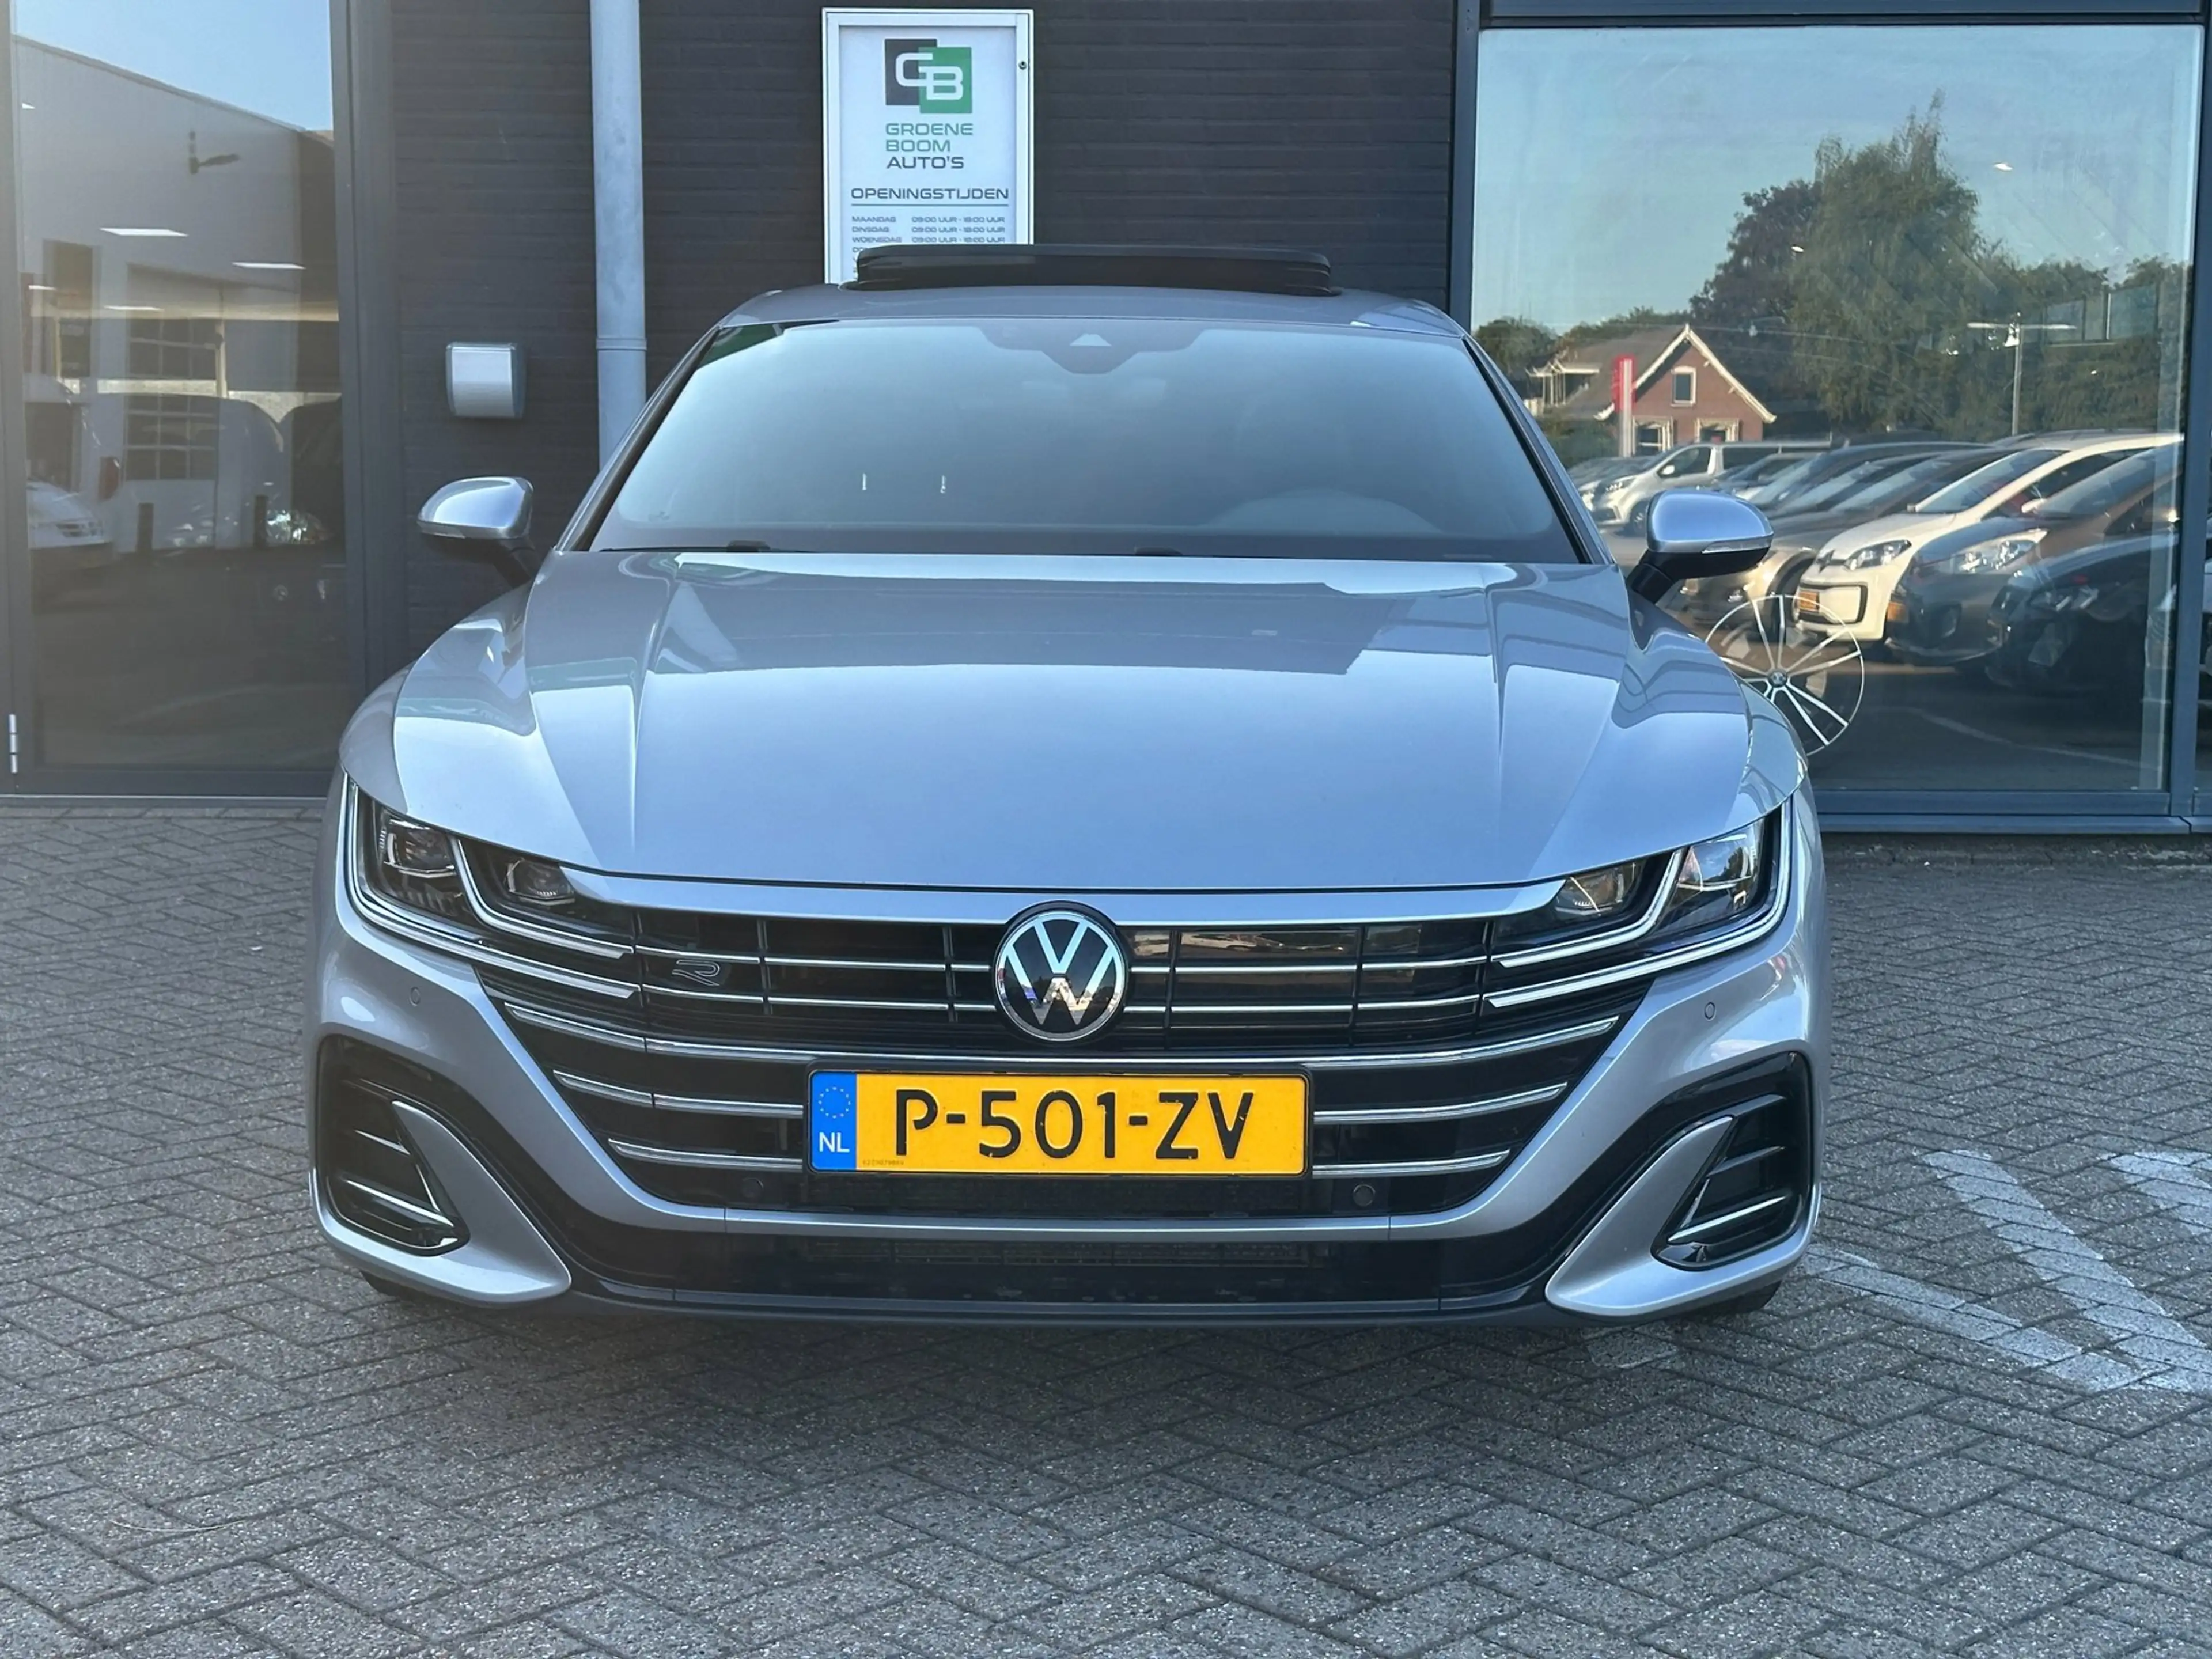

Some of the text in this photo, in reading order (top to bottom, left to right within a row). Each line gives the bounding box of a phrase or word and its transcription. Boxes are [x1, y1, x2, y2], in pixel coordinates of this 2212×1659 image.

[885, 123, 974, 136] GROENE
[885, 139, 951, 153] BOOM
[886, 156, 965, 169] AUTO'S
[851, 188, 1009, 200] OPENINGSTIJDEN
[896, 1089, 1254, 1160] P-501-ZV
[819, 1132, 850, 1153] NL
